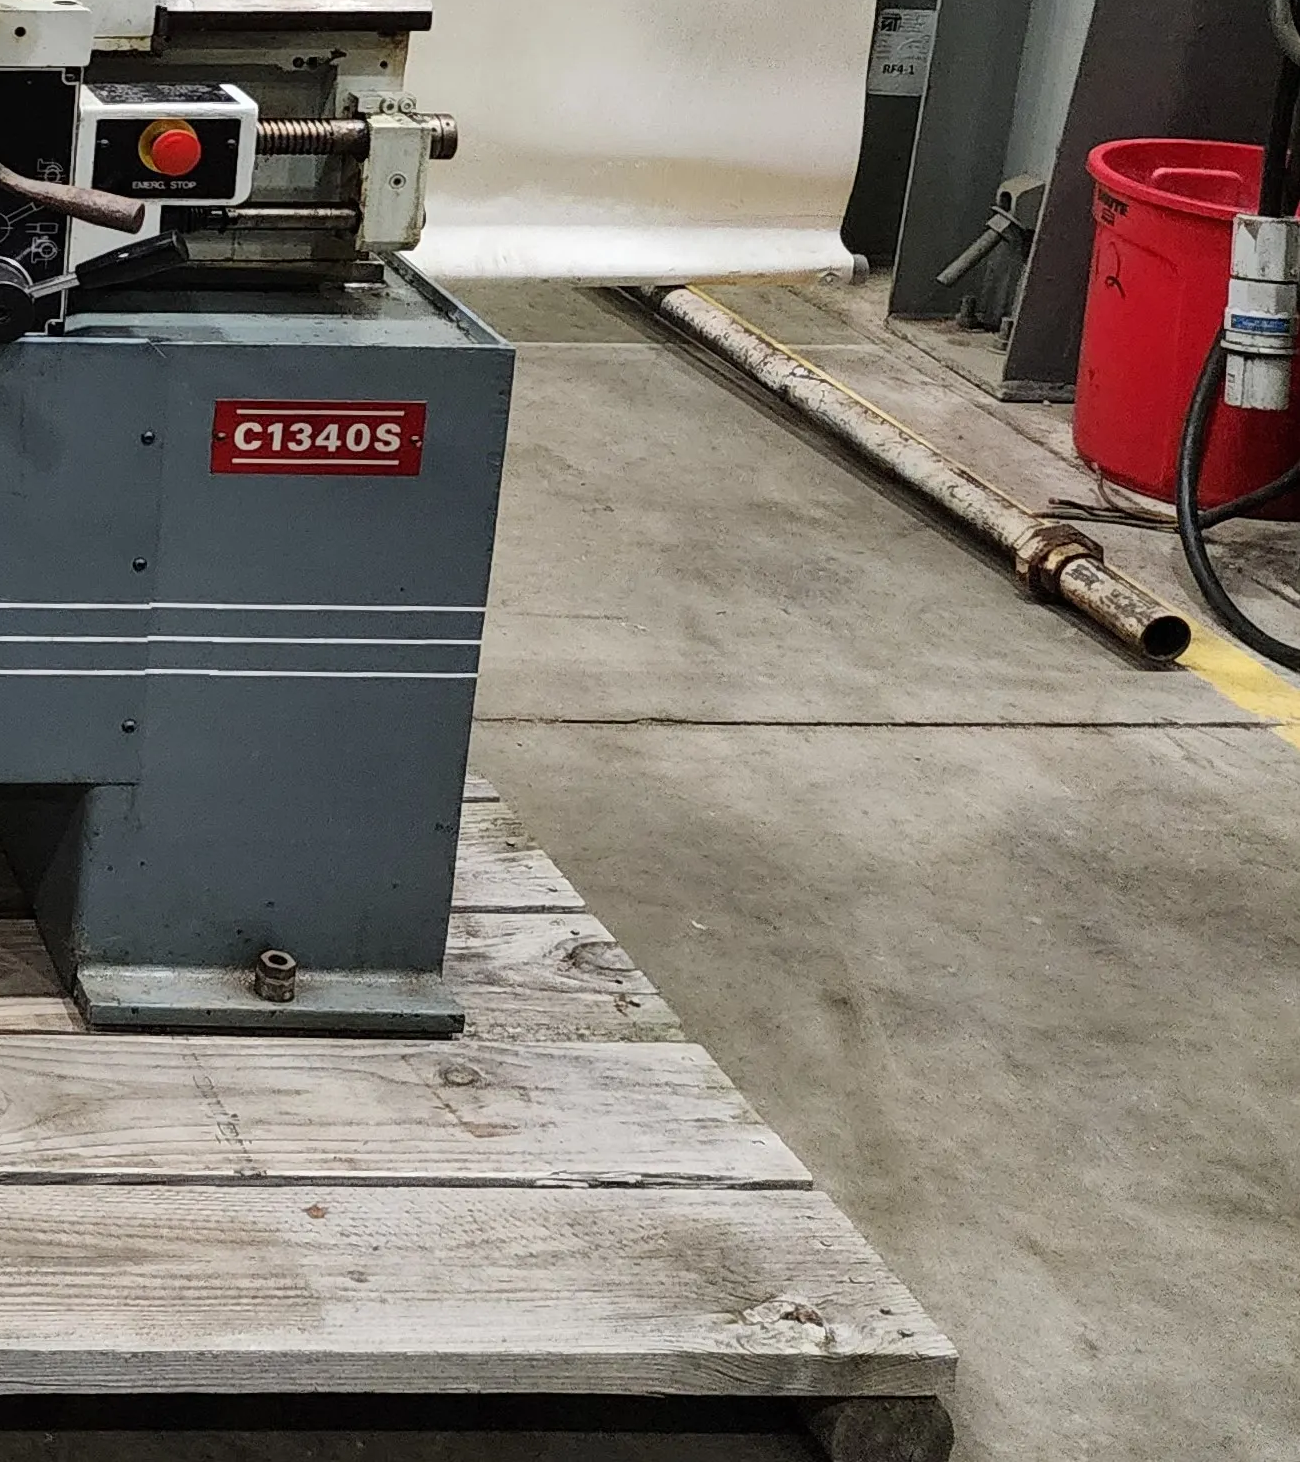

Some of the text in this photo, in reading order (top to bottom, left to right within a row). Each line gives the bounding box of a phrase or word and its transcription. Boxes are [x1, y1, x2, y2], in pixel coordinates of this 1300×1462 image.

[882, 63, 914, 75] RF4-1
[169, 181, 197, 189] STOP
[234, 422, 401, 452] C1340S
